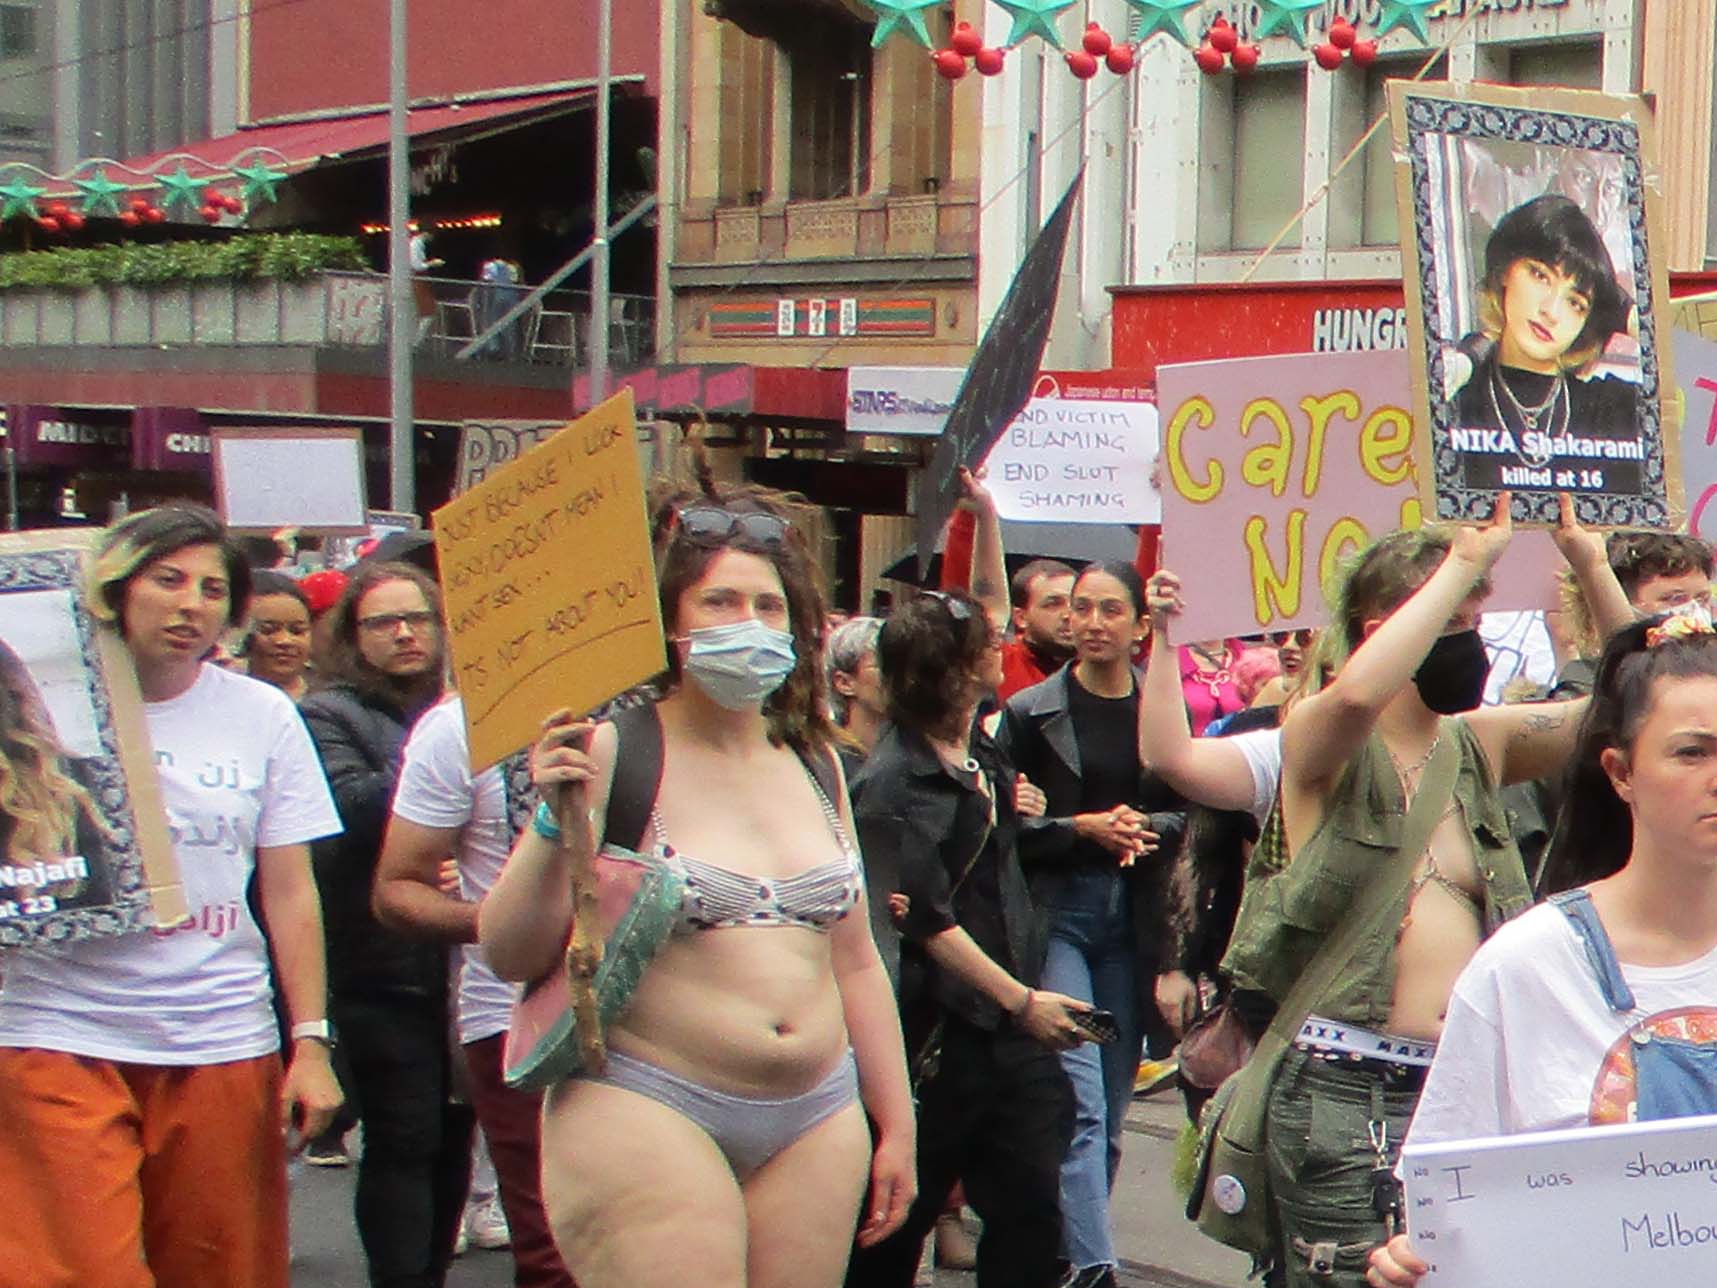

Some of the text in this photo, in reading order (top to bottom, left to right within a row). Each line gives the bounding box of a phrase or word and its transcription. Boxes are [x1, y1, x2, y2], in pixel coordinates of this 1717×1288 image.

[1056, 409, 1131, 428] VICTIM
[1011, 429, 1125, 453] BLAMING
[1450, 428, 1646, 460] NIKA Shakarami
[1004, 464, 1049, 482] END
[1502, 466, 1604, 488] killed at 16
[1018, 490, 1125, 508] SHAMING
[1440, 1165, 1476, 1202] I
[1526, 1172, 1574, 1190] was
